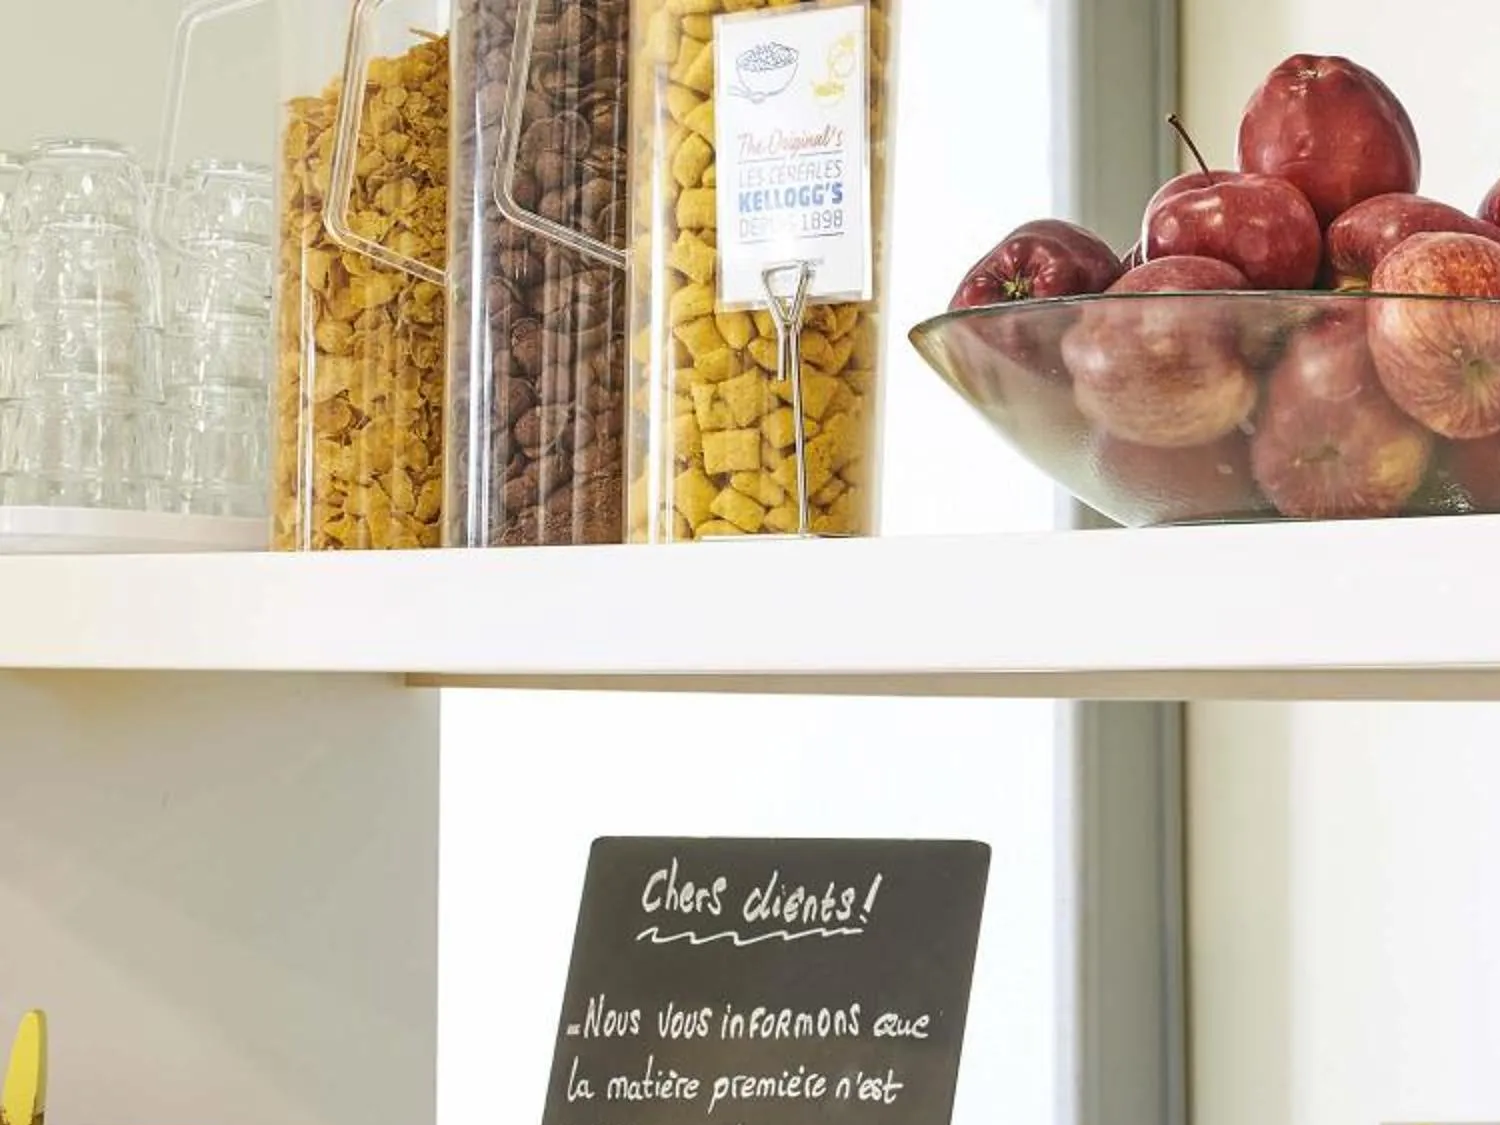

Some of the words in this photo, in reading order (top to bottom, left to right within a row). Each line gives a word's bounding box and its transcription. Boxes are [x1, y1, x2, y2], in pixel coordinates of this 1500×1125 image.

[738, 182, 844, 213] KELLOGG'S
[801, 208, 844, 232] 1898
[641, 857, 727, 916] Chers
[607, 1055, 700, 1101] matière
[706, 1064, 828, 1116] première
[835, 1069, 904, 1105] n'est
